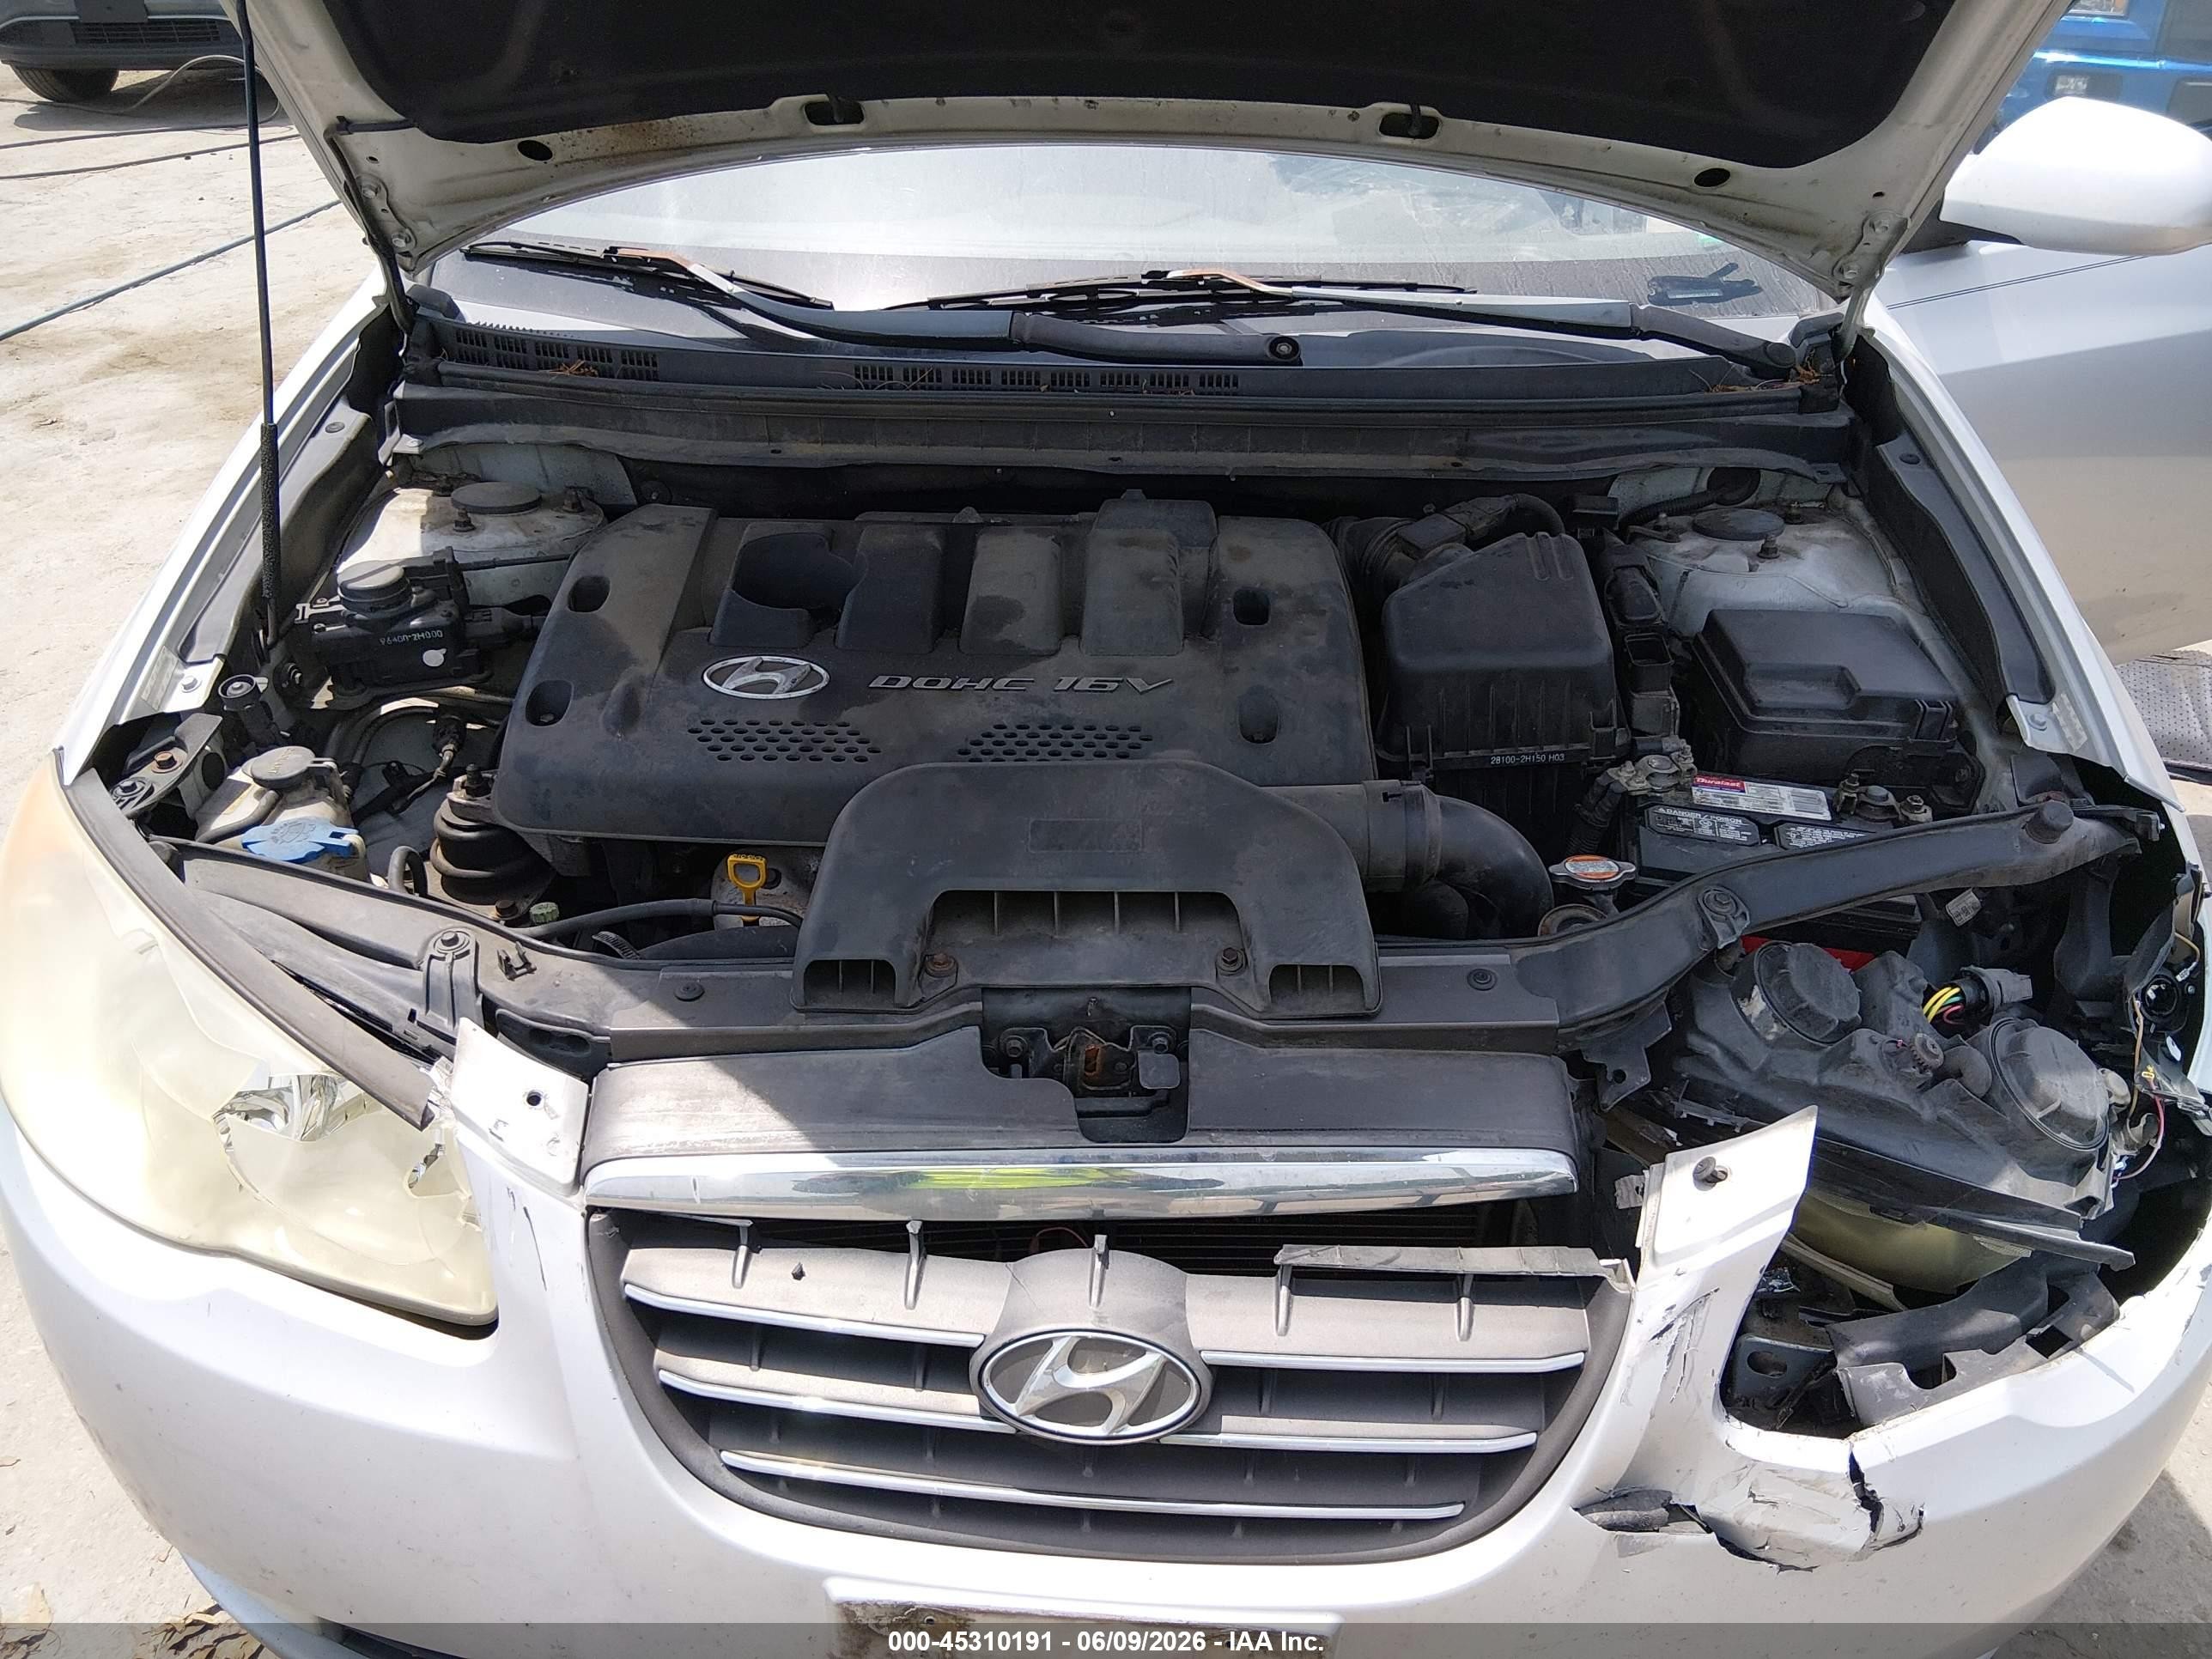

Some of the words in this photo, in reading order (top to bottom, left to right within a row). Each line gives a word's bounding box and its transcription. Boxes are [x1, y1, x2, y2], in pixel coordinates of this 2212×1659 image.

[868, 675, 1036, 690] DOHC
[1053, 676, 1173, 694] 16V
[1490, 754, 1547, 765] 28100-2H150
[1548, 753, 1565, 763] H03
[1695, 776, 1741, 787] Duralast
[1666, 808, 1701, 819] DANGER
[1710, 815, 1742, 824] POISON
